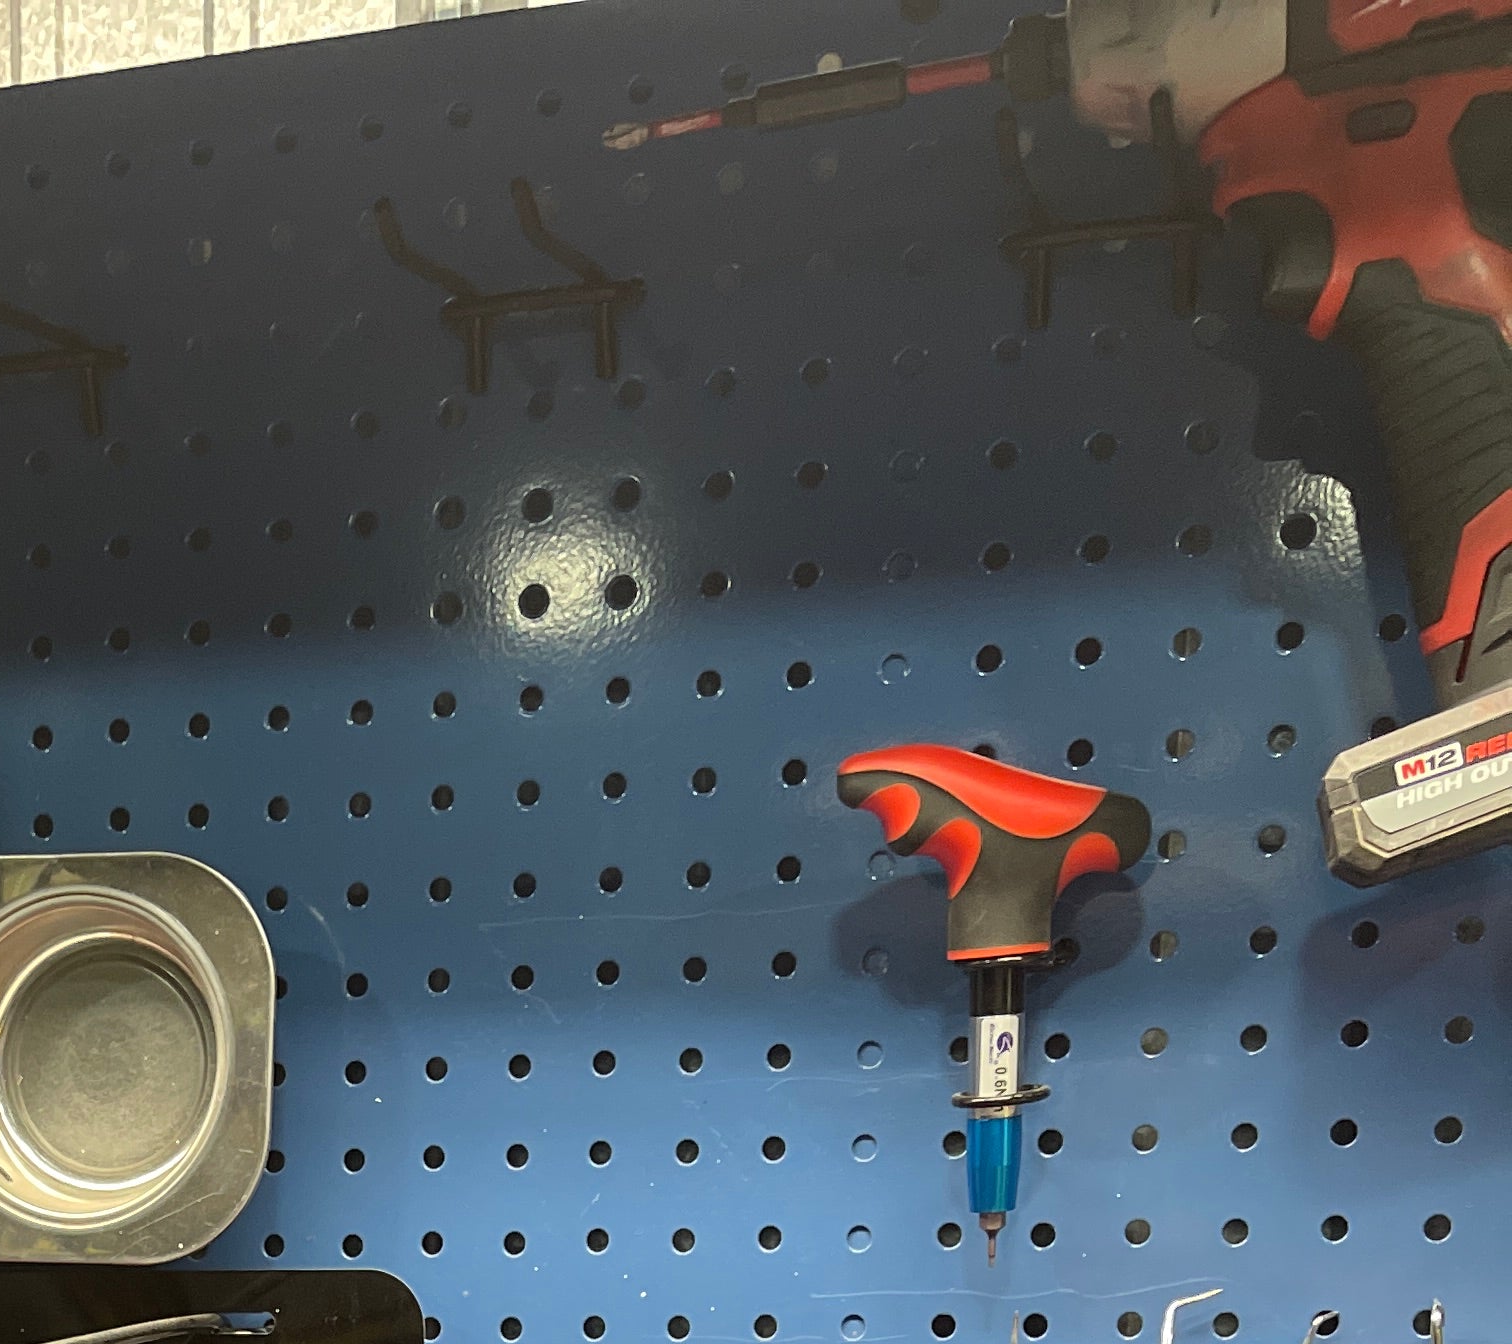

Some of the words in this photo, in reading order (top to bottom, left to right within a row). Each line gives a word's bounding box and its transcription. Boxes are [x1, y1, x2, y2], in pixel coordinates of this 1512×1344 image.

[1396, 773, 1462, 809] HIGH
[1471, 757, 1512, 784] OU
[1401, 749, 1457, 780] M12
